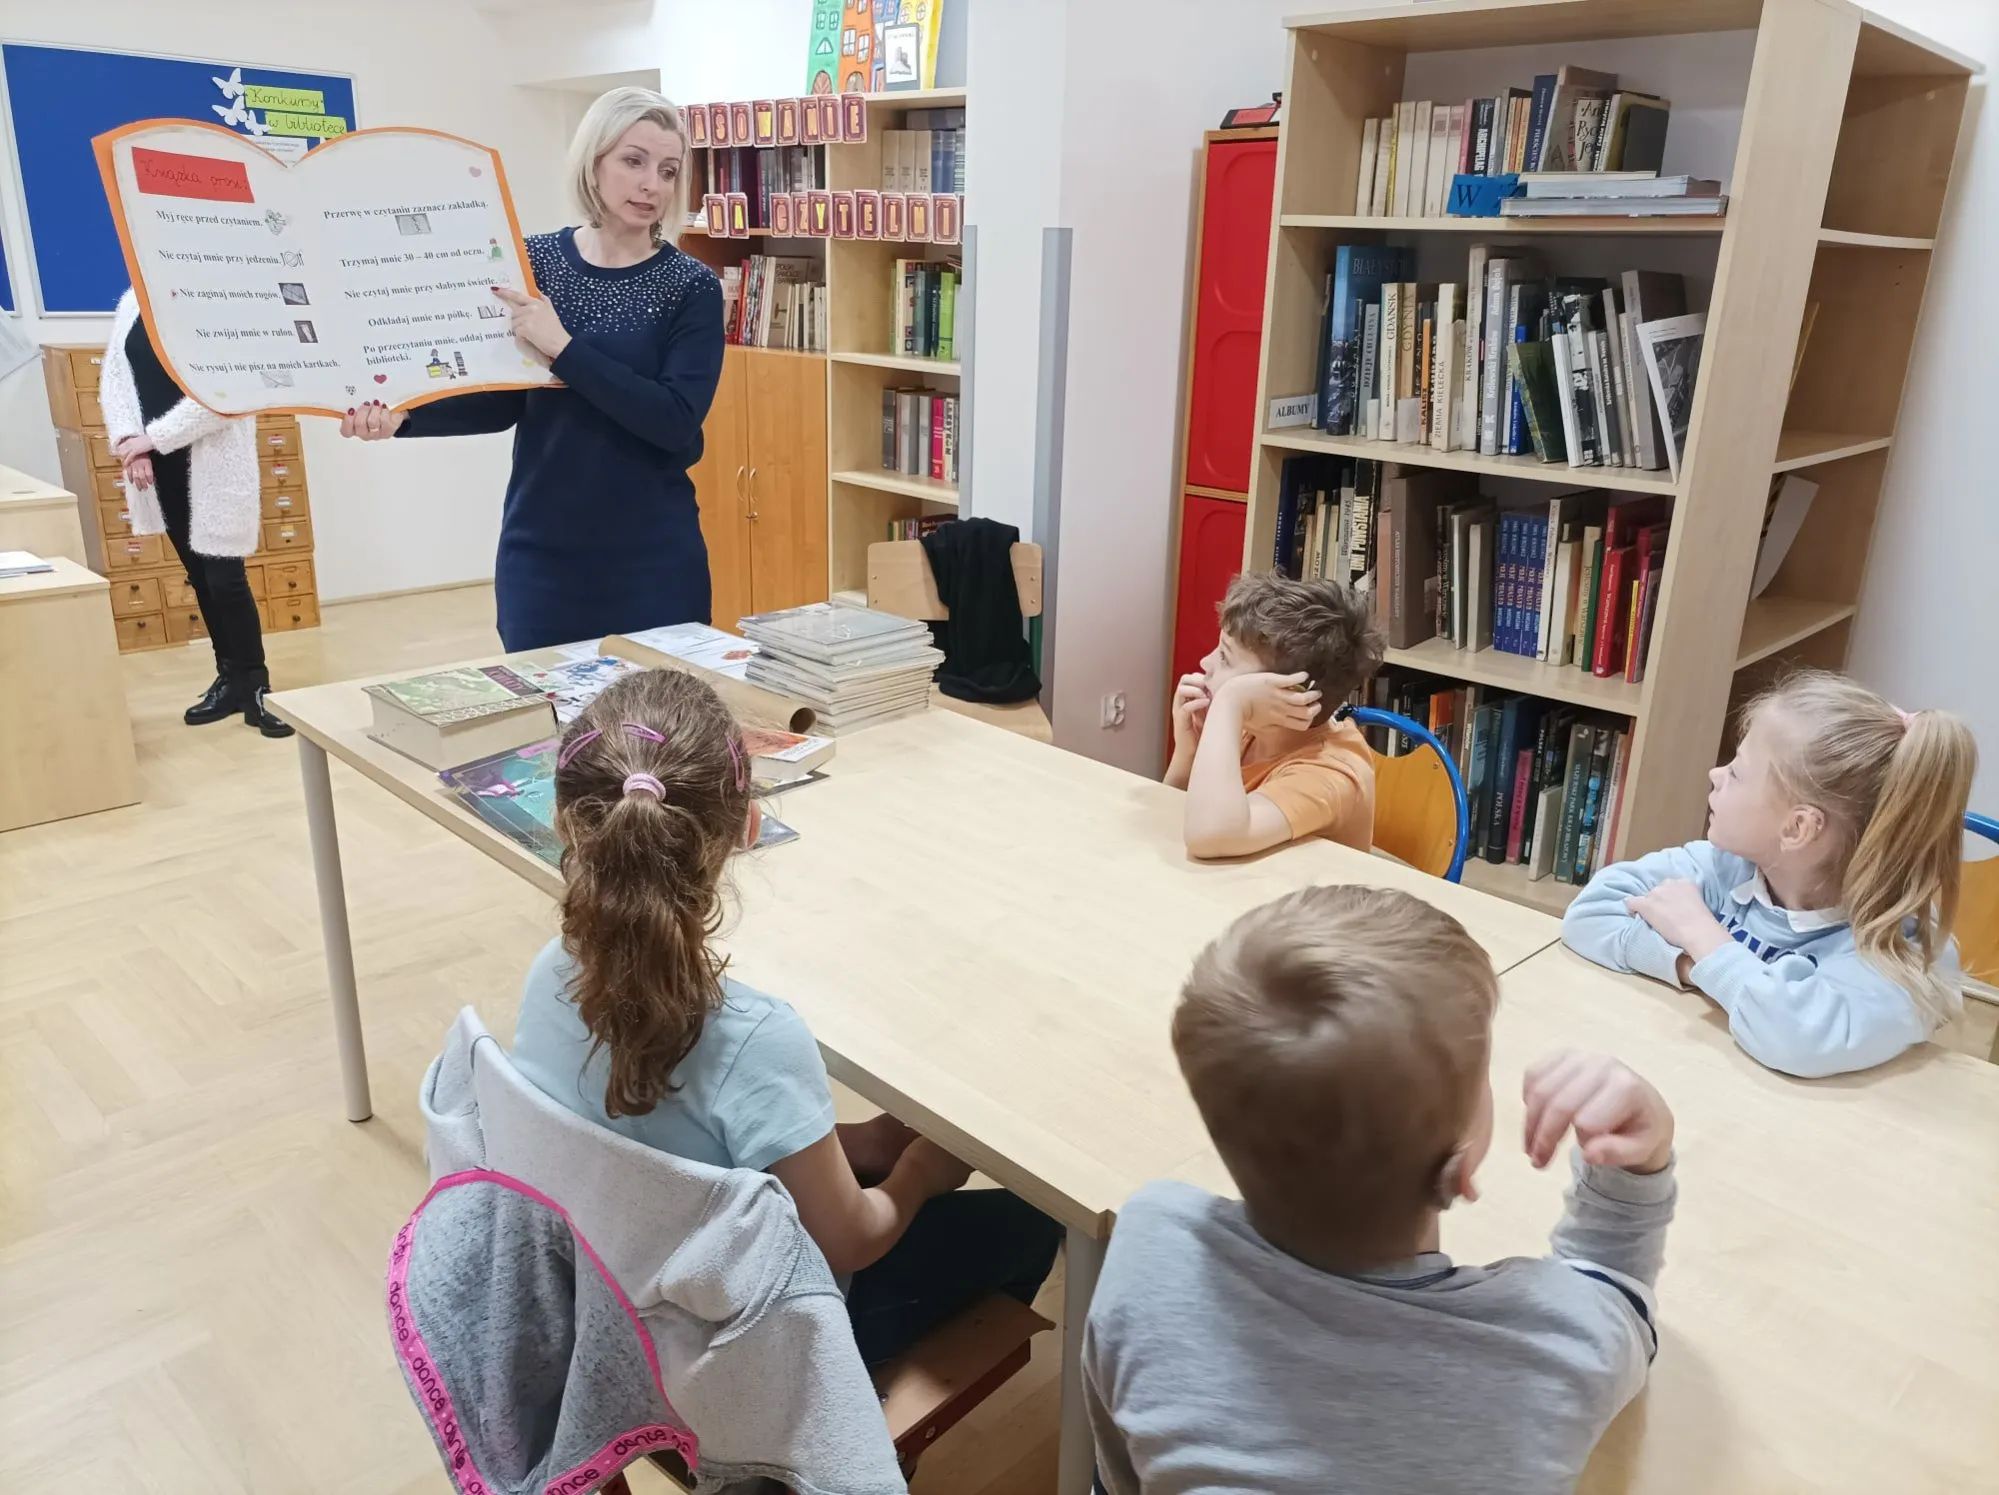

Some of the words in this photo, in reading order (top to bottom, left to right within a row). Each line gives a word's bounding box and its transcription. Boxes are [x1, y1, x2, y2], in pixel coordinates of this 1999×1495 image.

[250, 88, 320, 113] Konkursy
[286, 115, 345, 134] bibliotece
[694, 104, 860, 140] ASOWANIE
[1474, 128, 1488, 172] ARCHIPELAG
[1457, 184, 1482, 208] W
[156, 210, 174, 224] Myj
[196, 214, 219, 225] przed
[221, 215, 263, 228] czytaniem.
[324, 207, 362, 220] Przerwę
[373, 204, 410, 217] czytaniu
[412, 204, 446, 213] zaznacz
[777, 203, 950, 235] CZYTELNI
[159, 250, 174, 259] Nie
[176, 251, 202, 263] czytaj
[204, 252, 224, 263] mnie
[226, 254, 245, 265] przy
[246, 253, 281, 265] jedzeniu.
[340, 256, 379, 268] Trzymaj
[380, 254, 402, 264] mnie
[404, 253, 414, 262] 30
[424, 251, 433, 260] 40
[436, 251, 448, 259] cm
[450, 249, 461, 258] od
[463, 248, 484, 257] oczu.
[180, 288, 195, 298] Nie
[197, 289, 227, 301] zaginaj
[230, 289, 253, 299] moich
[344, 290, 361, 299] Nie
[363, 287, 389, 299] czytaj
[391, 286, 413, 296] mnie
[415, 285, 433, 296] przy
[369, 315, 410, 328] Odkładaj
[412, 314, 433, 323] mnie
[196, 328, 210, 338] Nie
[212, 329, 239, 341] zwijaj
[241, 329, 261, 338] mnie
[271, 328, 295, 337] rulon.
[363, 344, 376, 354] Po
[378, 339, 433, 354] przeczytaniu
[460, 333, 483, 344] oddaj
[485, 332, 505, 341] mnie
[190, 362, 204, 371] Nie
[206, 362, 227, 374] rysuj
[234, 362, 247, 371] nie
[249, 362, 264, 373] pisz
[279, 361, 302, 370] moich
[303, 359, 340, 369] kartkach.
[367, 353, 411, 366] biblioteki.
[1437, 361, 1445, 404] KIELECKA
[1275, 403, 1309, 418] ALBUMY
[1434, 407, 1443, 438] ZIEMIA
[1353, 496, 1369, 551] POWSTANIA
[1350, 552, 1365, 571] DNI
[1493, 791, 1503, 825] POLSKA
[389, 1281, 411, 1342] dance
[412, 1357, 445, 1413] dance
[614, 1428, 667, 1456] dance
